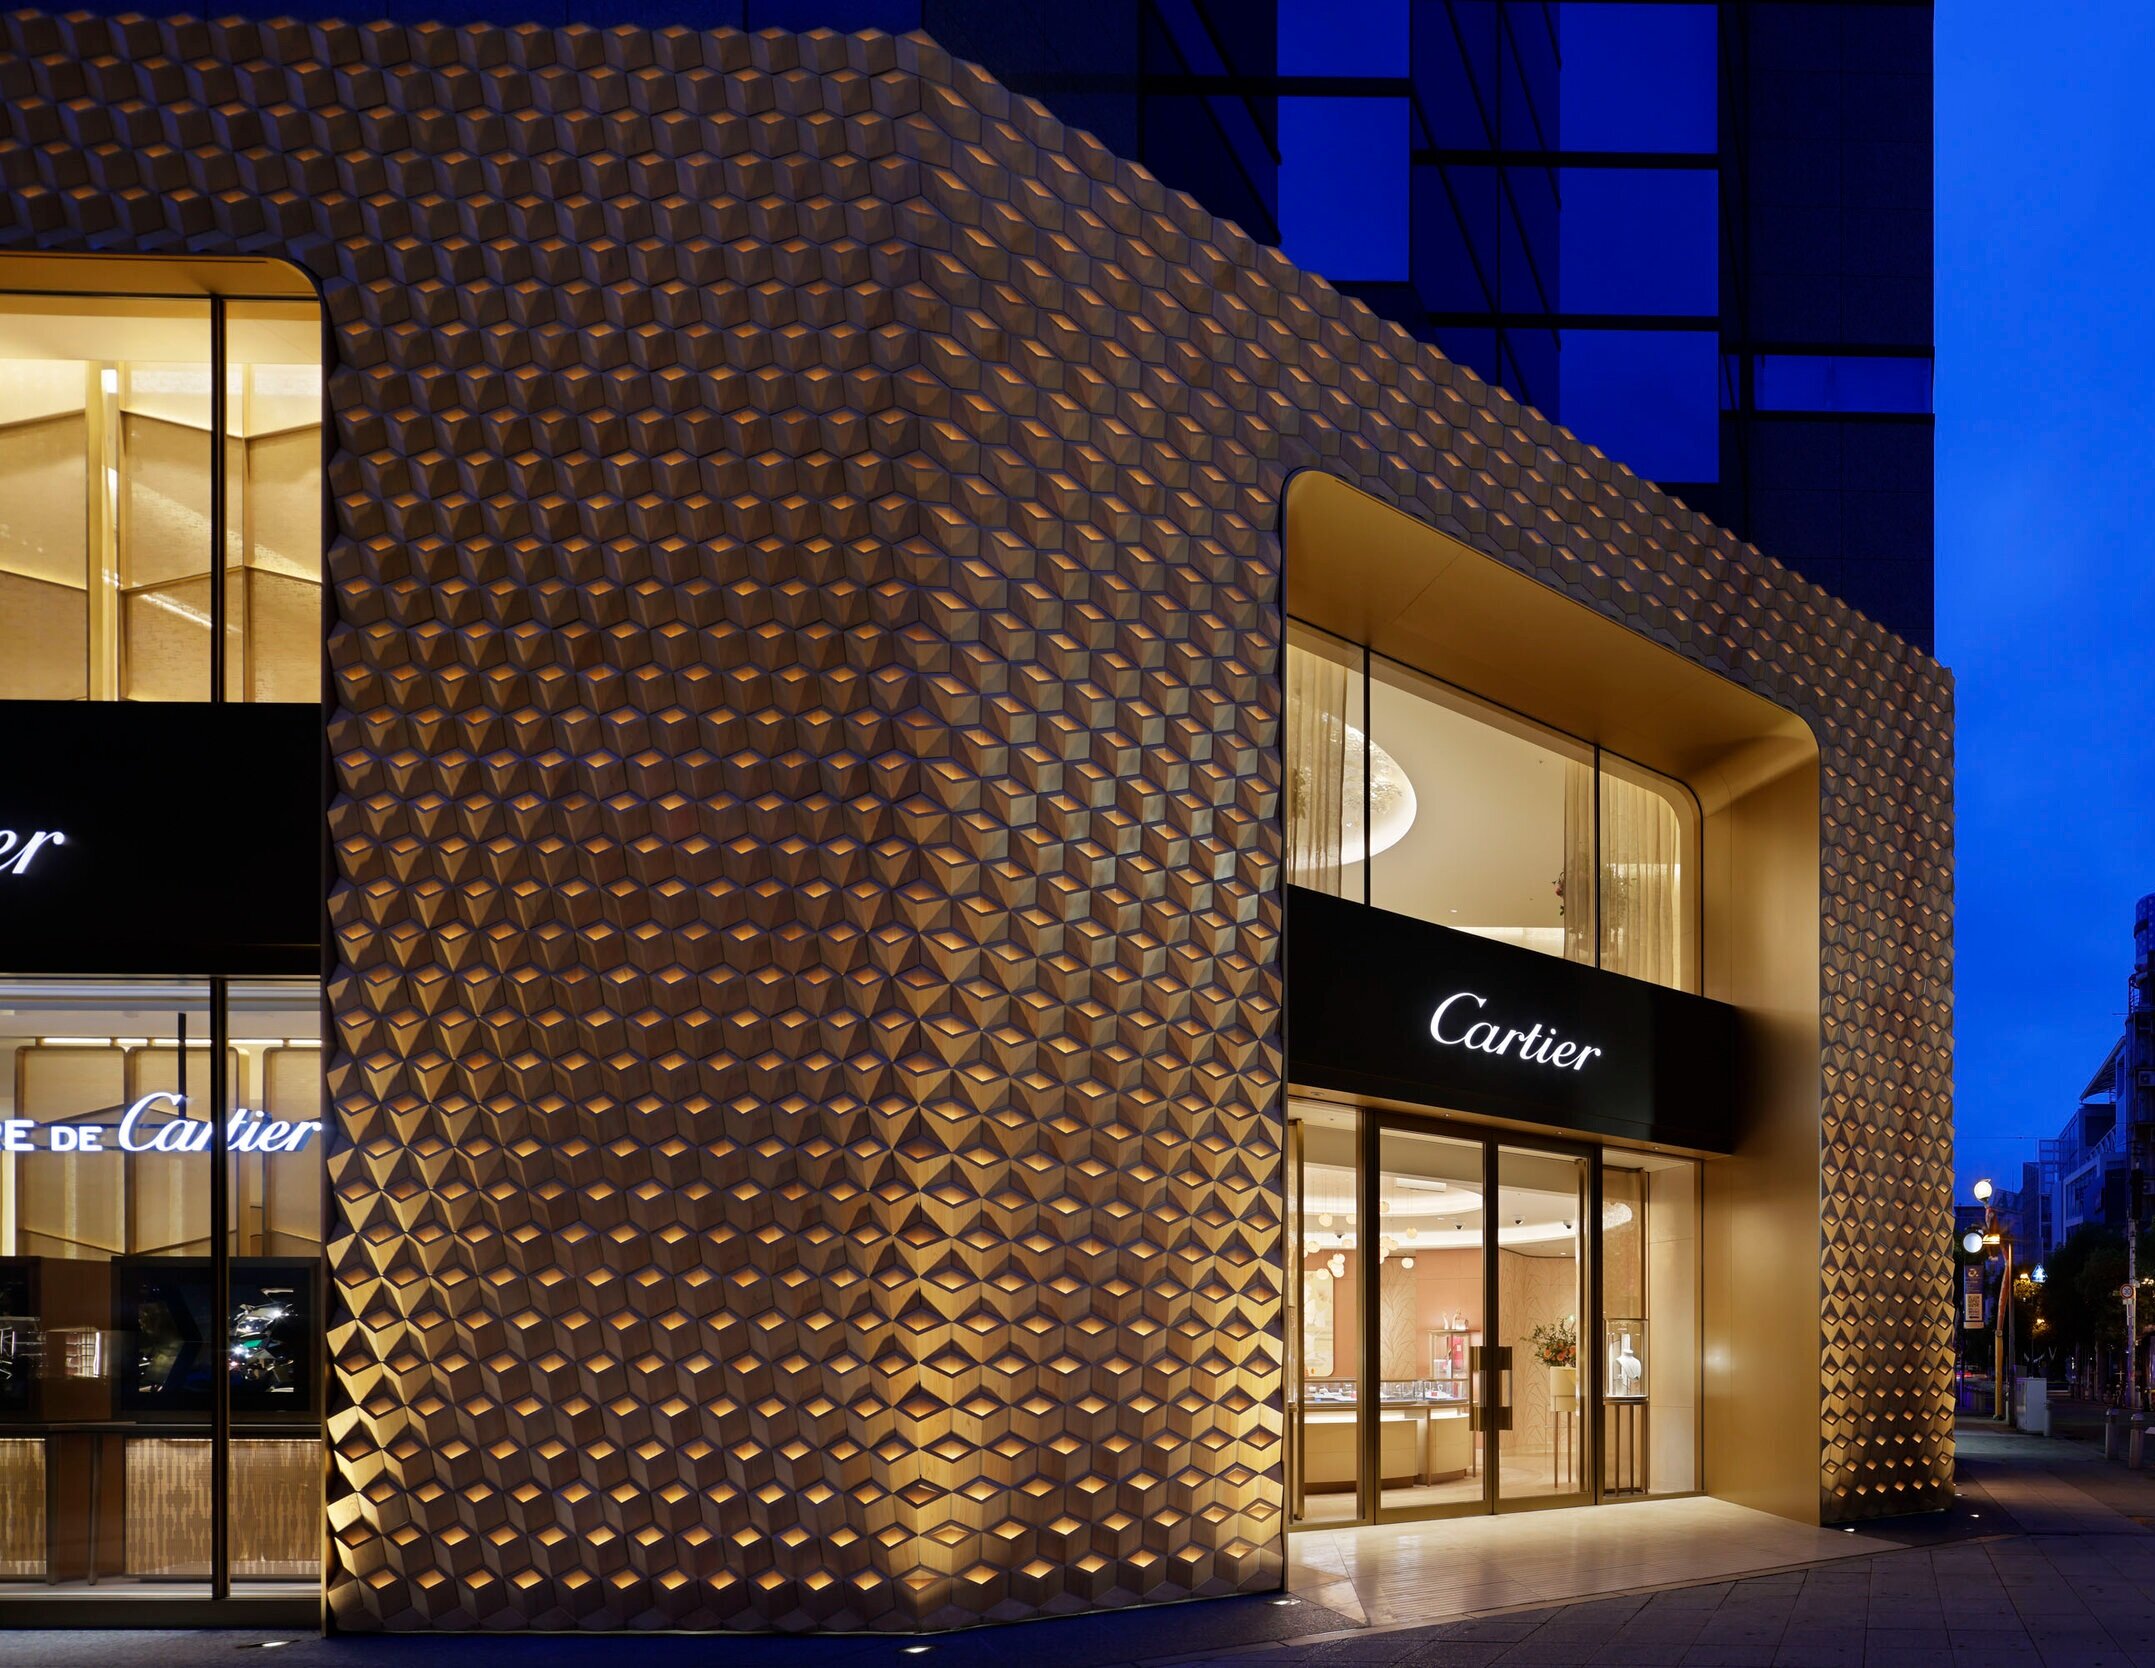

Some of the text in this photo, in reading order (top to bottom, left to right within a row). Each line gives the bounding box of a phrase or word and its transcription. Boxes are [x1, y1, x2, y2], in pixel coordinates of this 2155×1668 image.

[1430, 992, 1602, 1071] Cartier
[0, 1119, 35, 1151] E
[50, 1125, 103, 1152] DE
